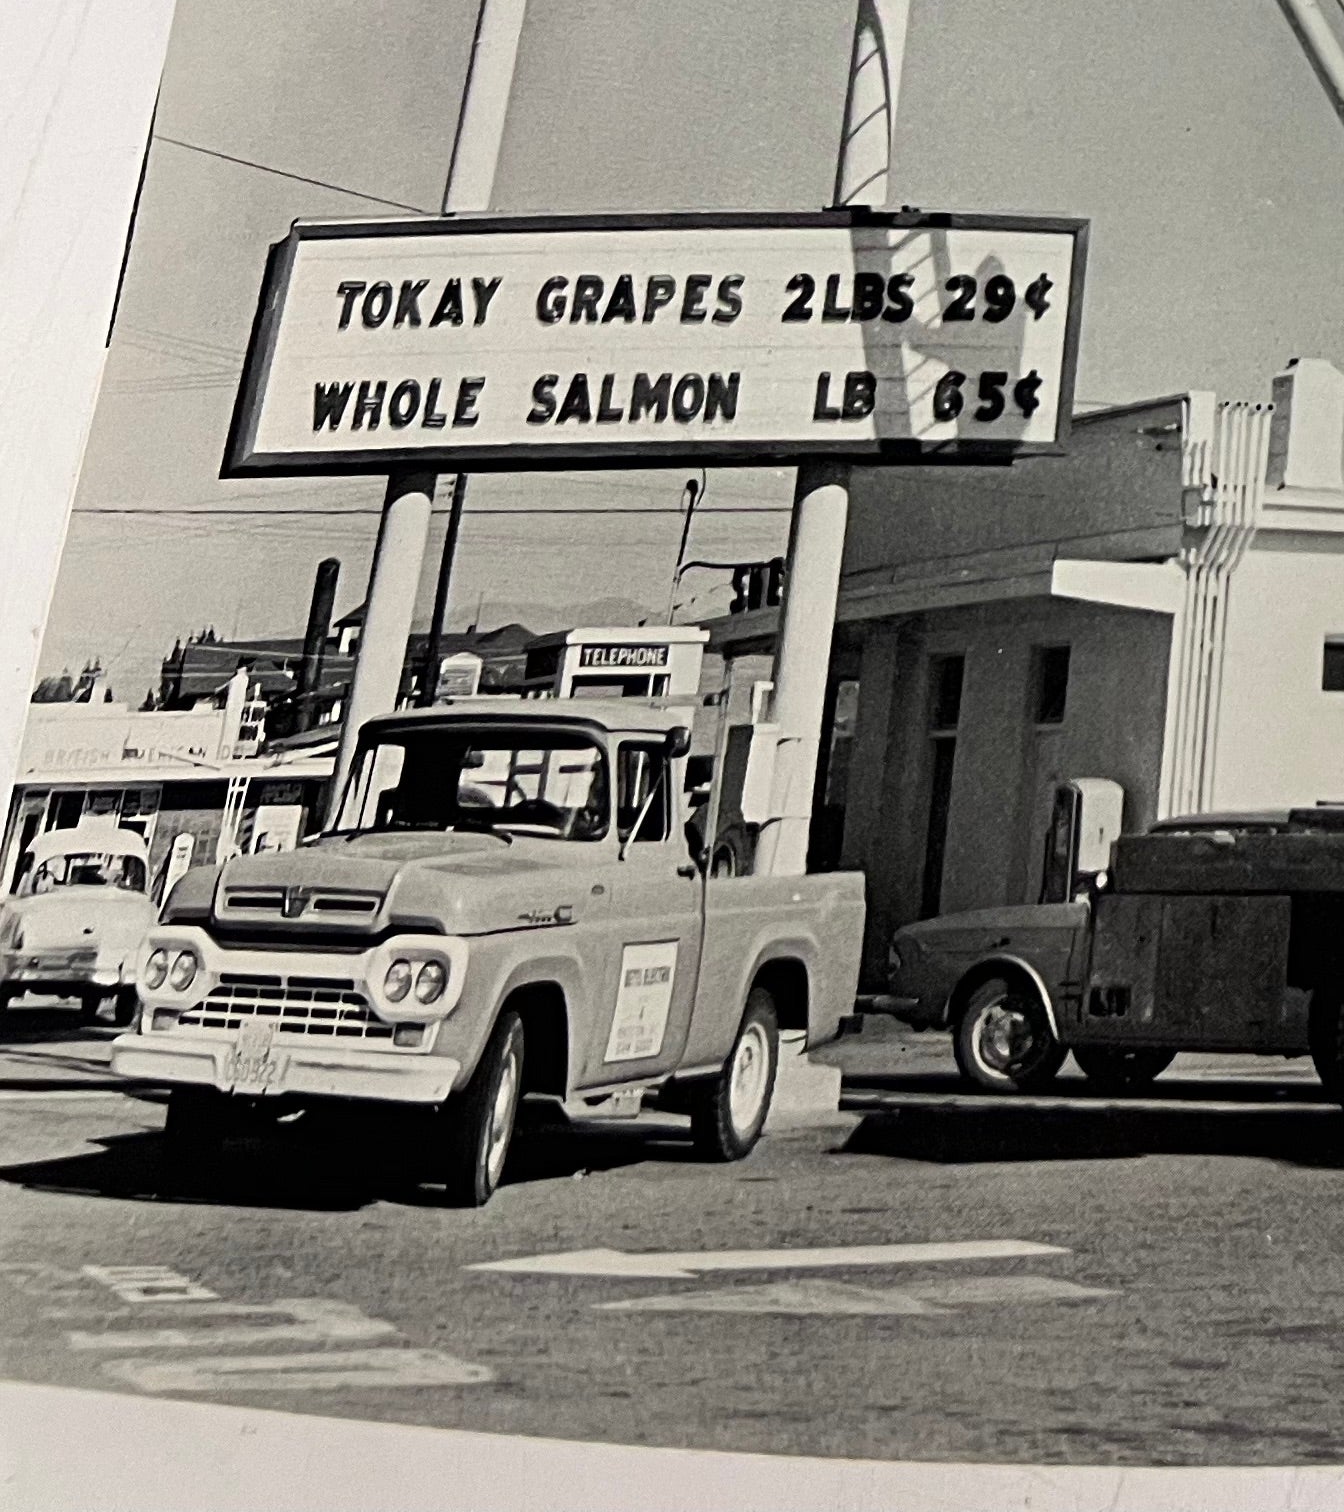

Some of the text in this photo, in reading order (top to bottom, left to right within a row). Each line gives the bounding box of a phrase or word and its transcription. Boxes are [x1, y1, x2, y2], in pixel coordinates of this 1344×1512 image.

[337, 275, 503, 332] TOKAY
[536, 273, 746, 327] GRAPES
[312, 376, 486, 433] WHOLE
[526, 371, 741, 426] SALMON
[812, 370, 878, 422] LB
[583, 647, 668, 667] TELEPHONE
